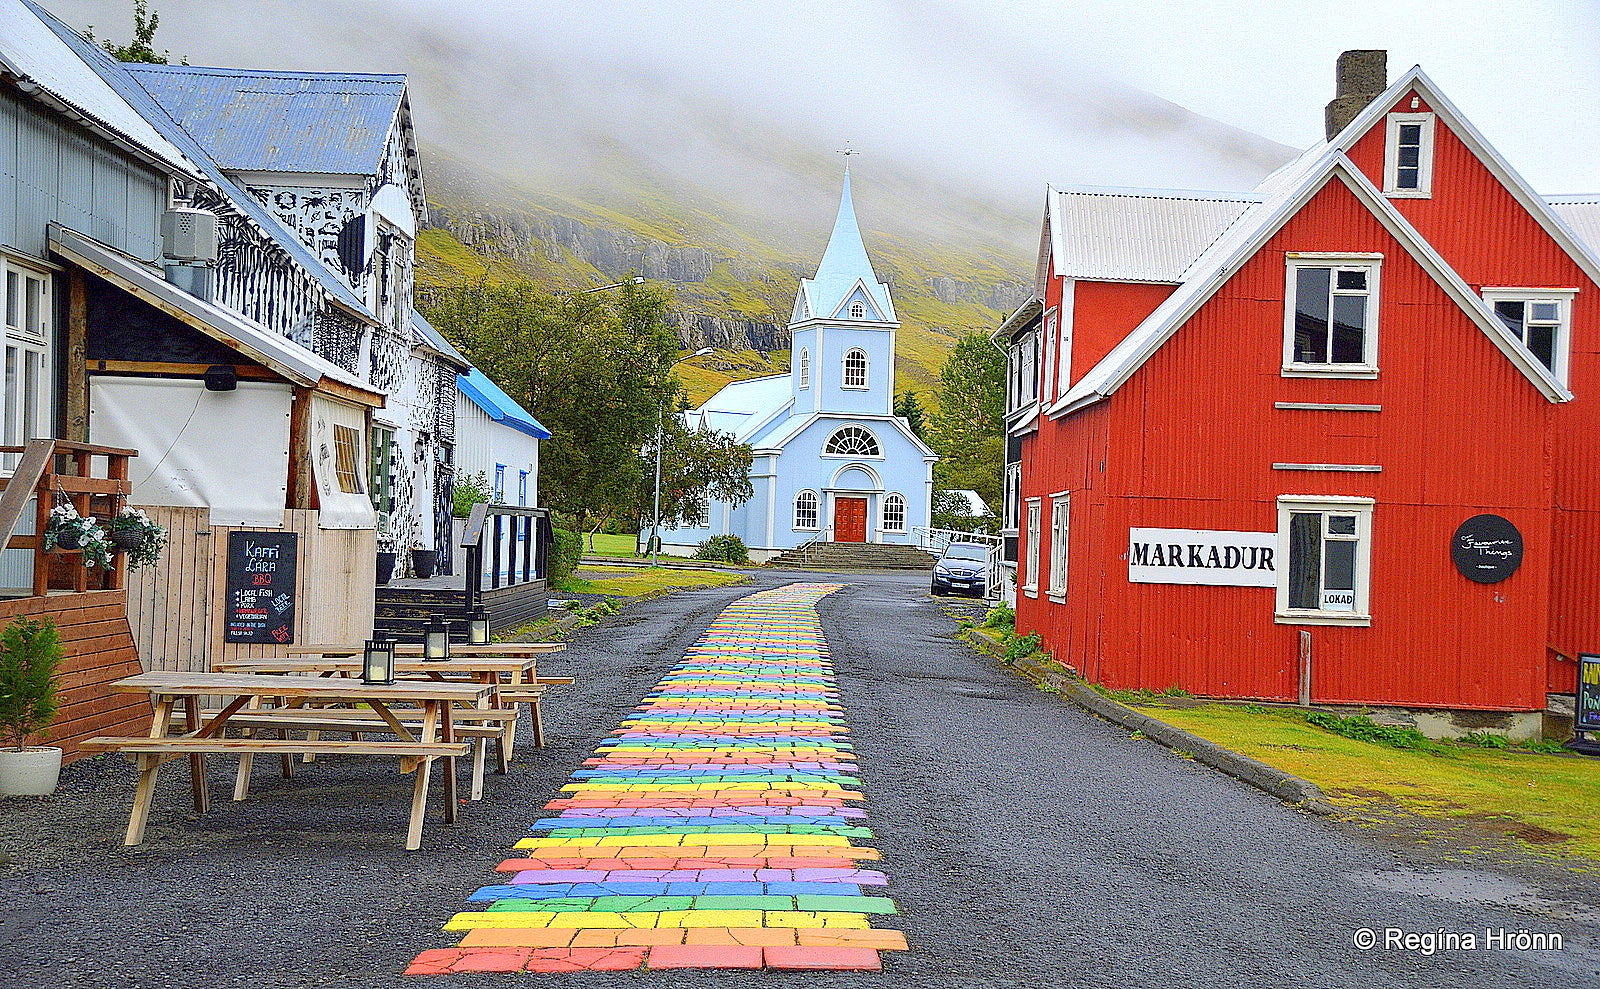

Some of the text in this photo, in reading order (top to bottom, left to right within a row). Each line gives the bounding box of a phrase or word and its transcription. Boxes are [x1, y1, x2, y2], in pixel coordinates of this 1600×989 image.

[1461, 538, 1513, 549] Favourite
[1130, 542, 1275, 571] MARKAÐUR
[1473, 545, 1513, 560] Things
[245, 557, 276, 572] LÁRA
[251, 573, 272, 585] BBQ
[240, 588, 258, 597] LOCAL
[270, 592, 290, 607] LOCAL
